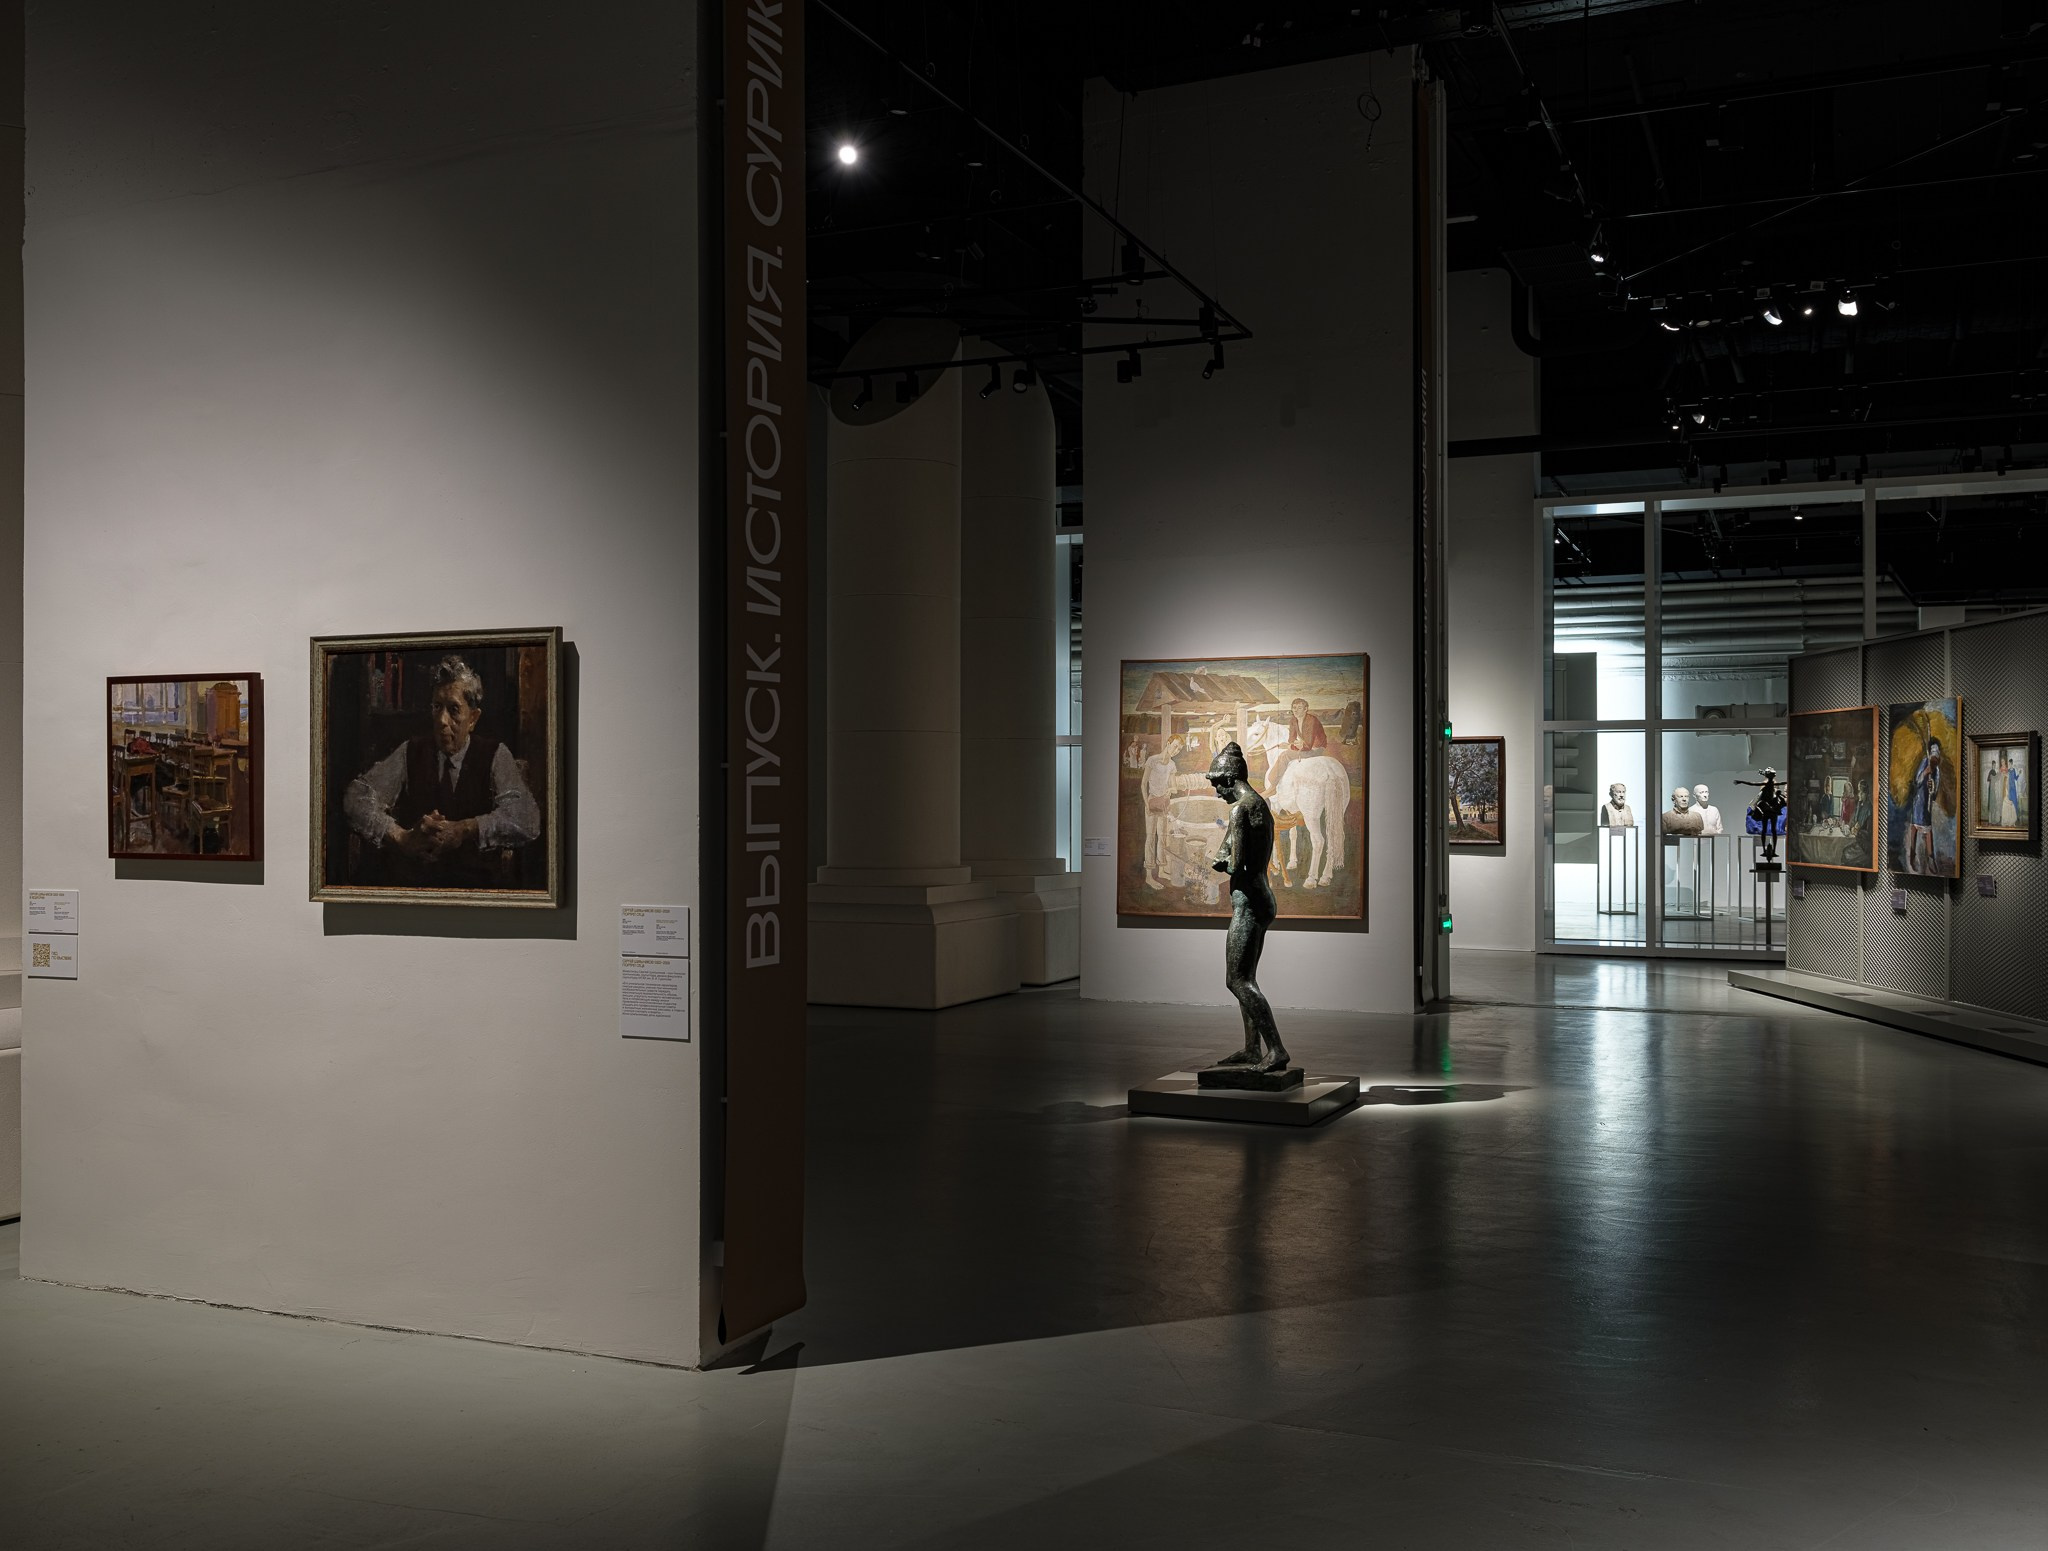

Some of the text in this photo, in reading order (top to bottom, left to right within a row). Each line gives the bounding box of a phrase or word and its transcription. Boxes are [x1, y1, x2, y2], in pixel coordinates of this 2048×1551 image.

[744, 0, 783, 969] ВЫПУСК. ИСТОРИЯ. СУРИК
